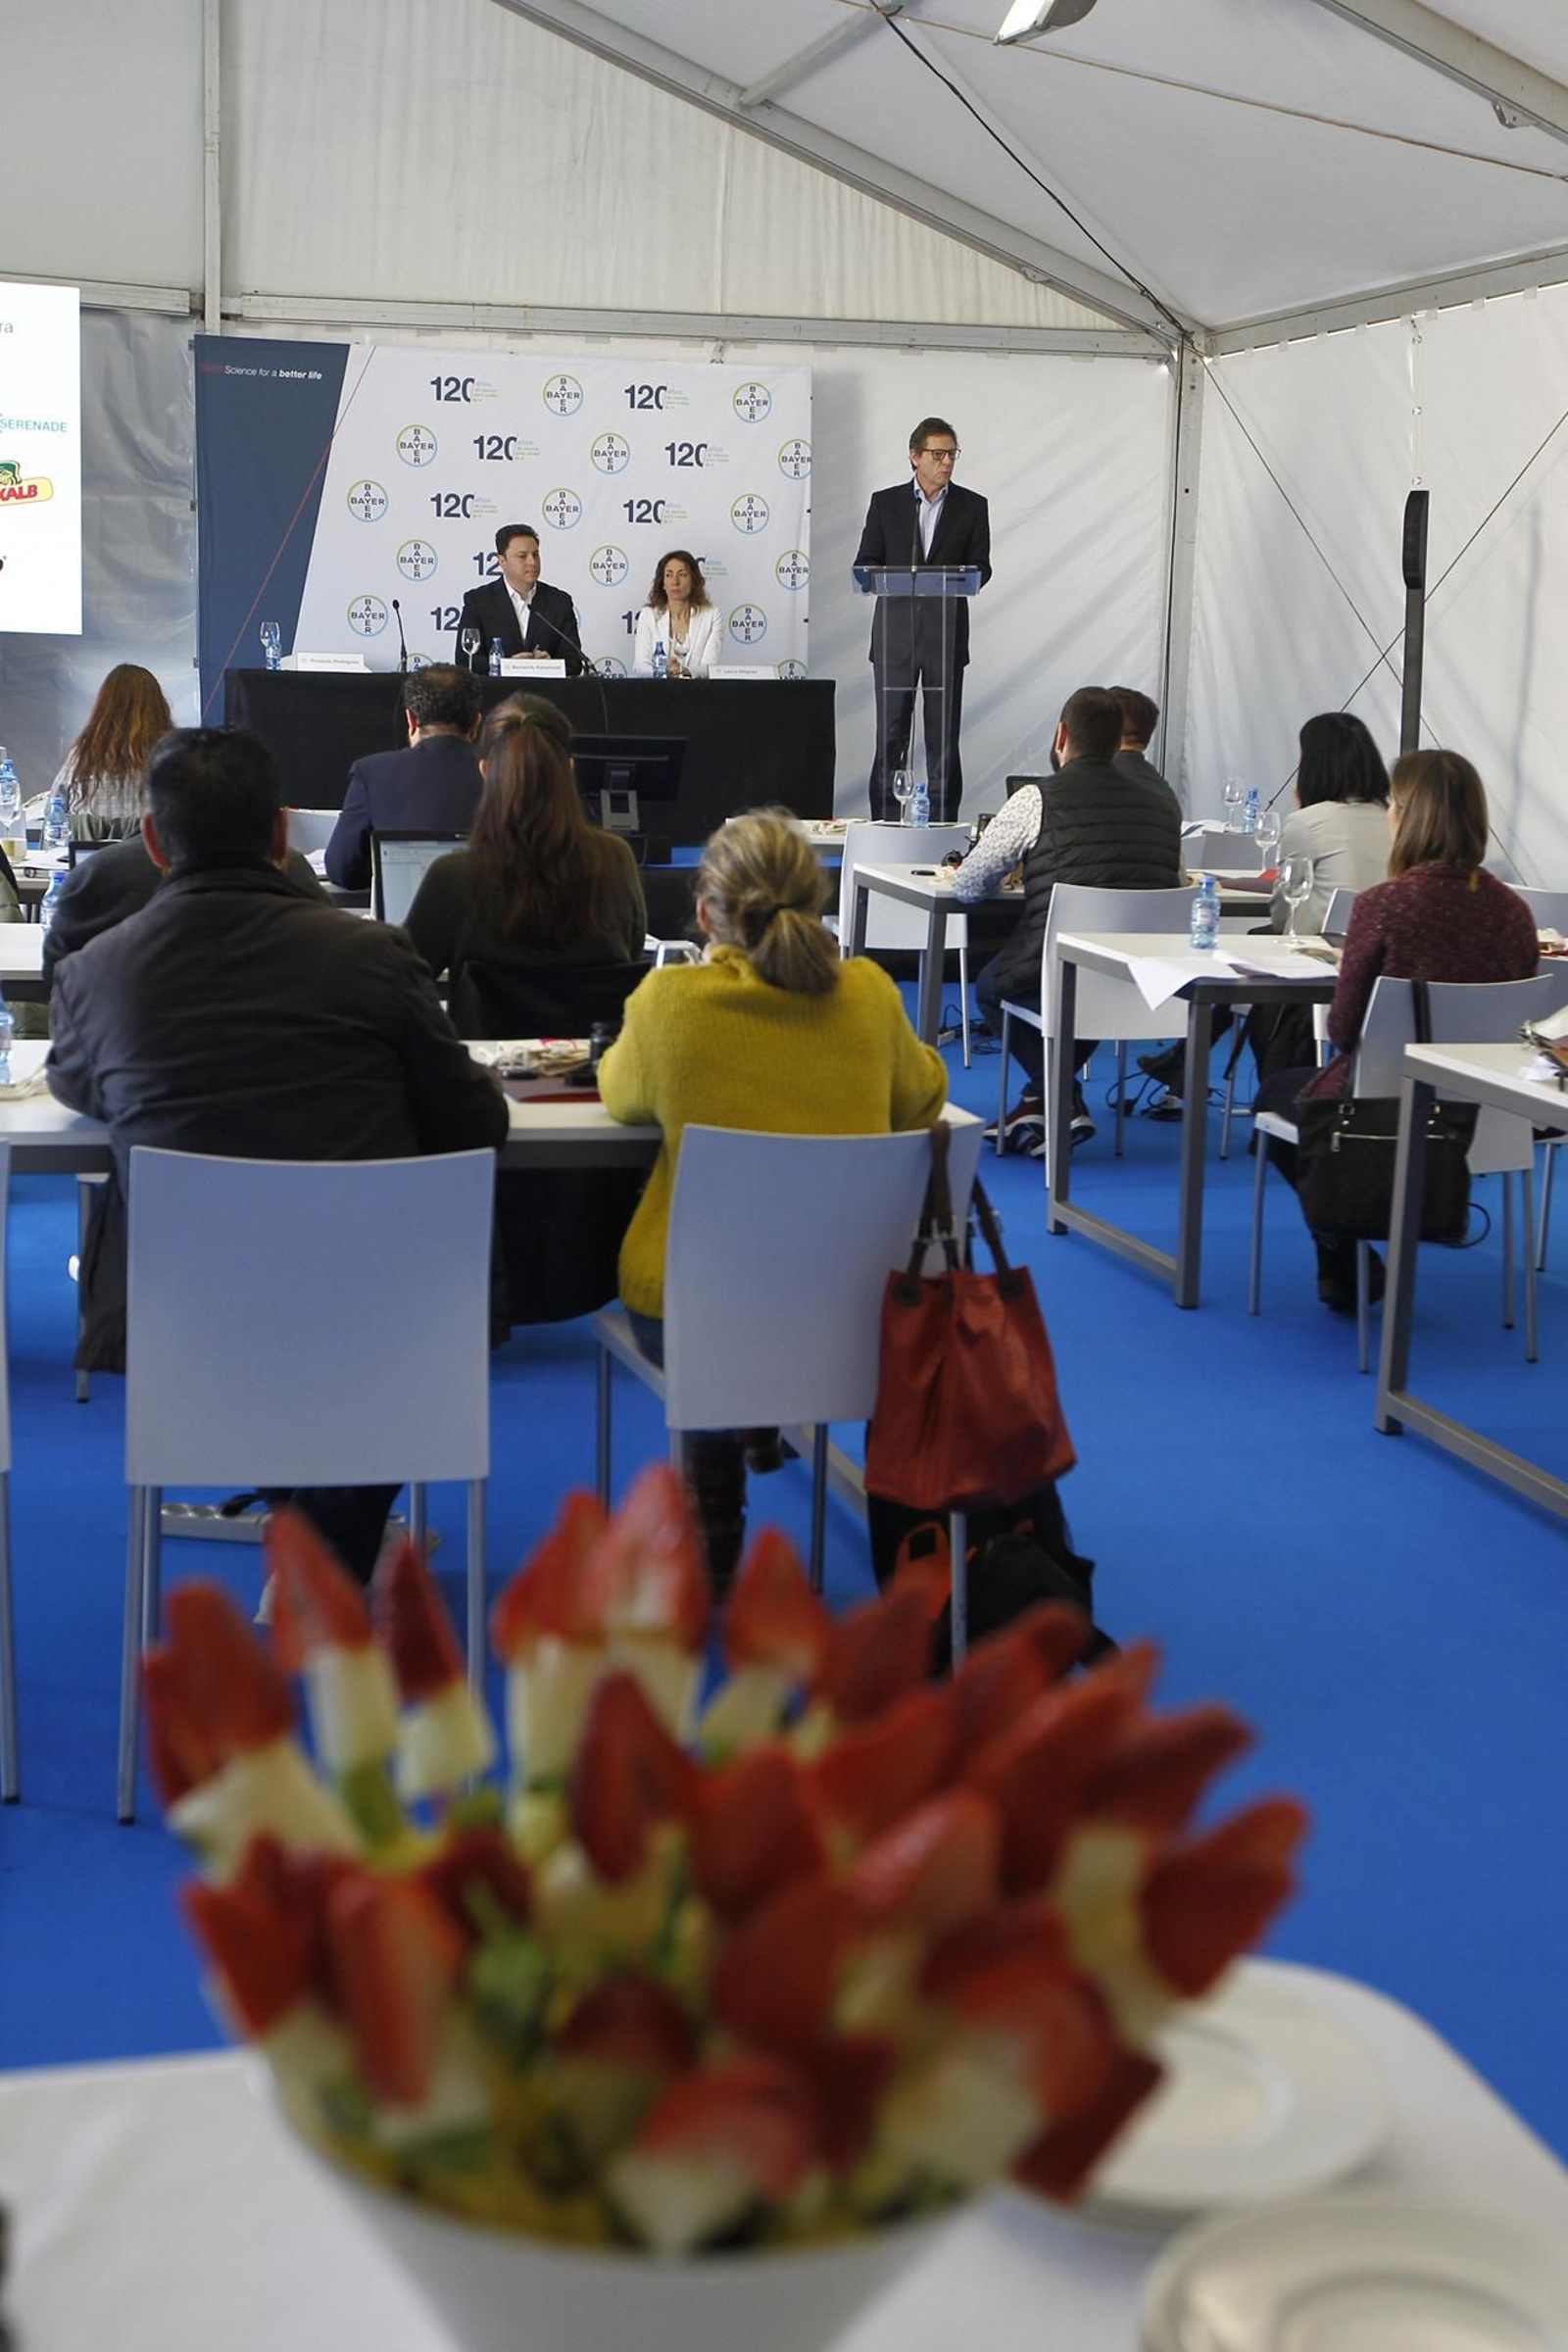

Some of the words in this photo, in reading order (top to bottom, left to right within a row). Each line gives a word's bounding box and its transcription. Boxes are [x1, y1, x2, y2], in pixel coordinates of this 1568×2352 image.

[224, 365, 257, 376] Science
[258, 368, 270, 377] for
[278, 368, 307, 380] better
[307, 370, 322, 380] life
[546, 391, 580, 400] BAYER
[736, 399, 768, 408] BAYER
[0, 417, 69, 432] SERENADE
[351, 497, 385, 506] BAYER
[545, 505, 579, 514] BAYER
[400, 557, 435, 565] BAYER
[472, 552, 503, 575] 12
[351, 612, 385, 620] BAYER
[430, 607, 460, 631] 12
